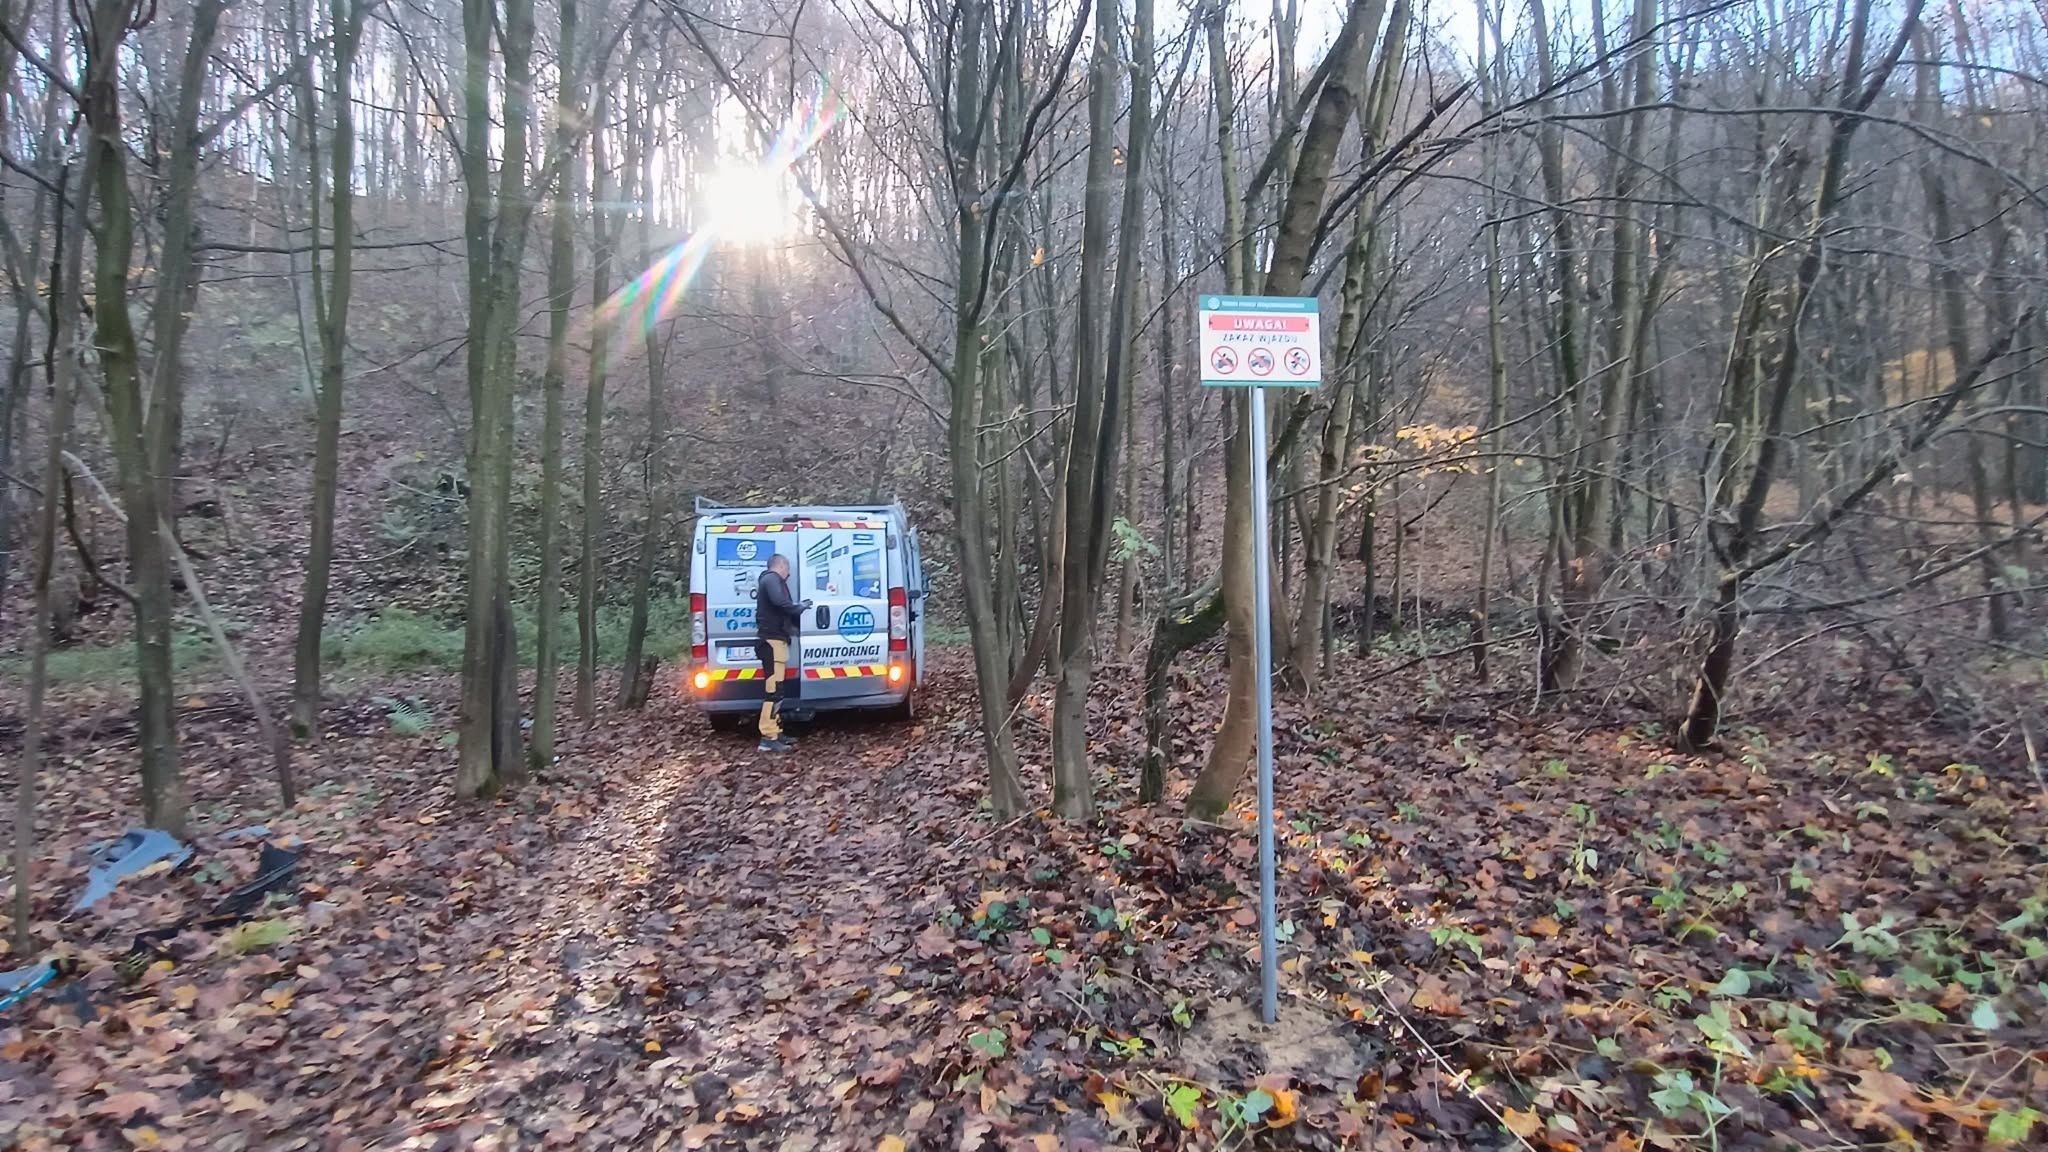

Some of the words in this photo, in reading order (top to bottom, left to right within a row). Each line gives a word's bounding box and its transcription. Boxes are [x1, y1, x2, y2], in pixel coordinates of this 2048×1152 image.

[1234, 318, 1287, 331] UWAGA!
[715, 608, 730, 618] tel.
[732, 608, 752, 618] 663
[804, 645, 880, 659] MONITORINGI
